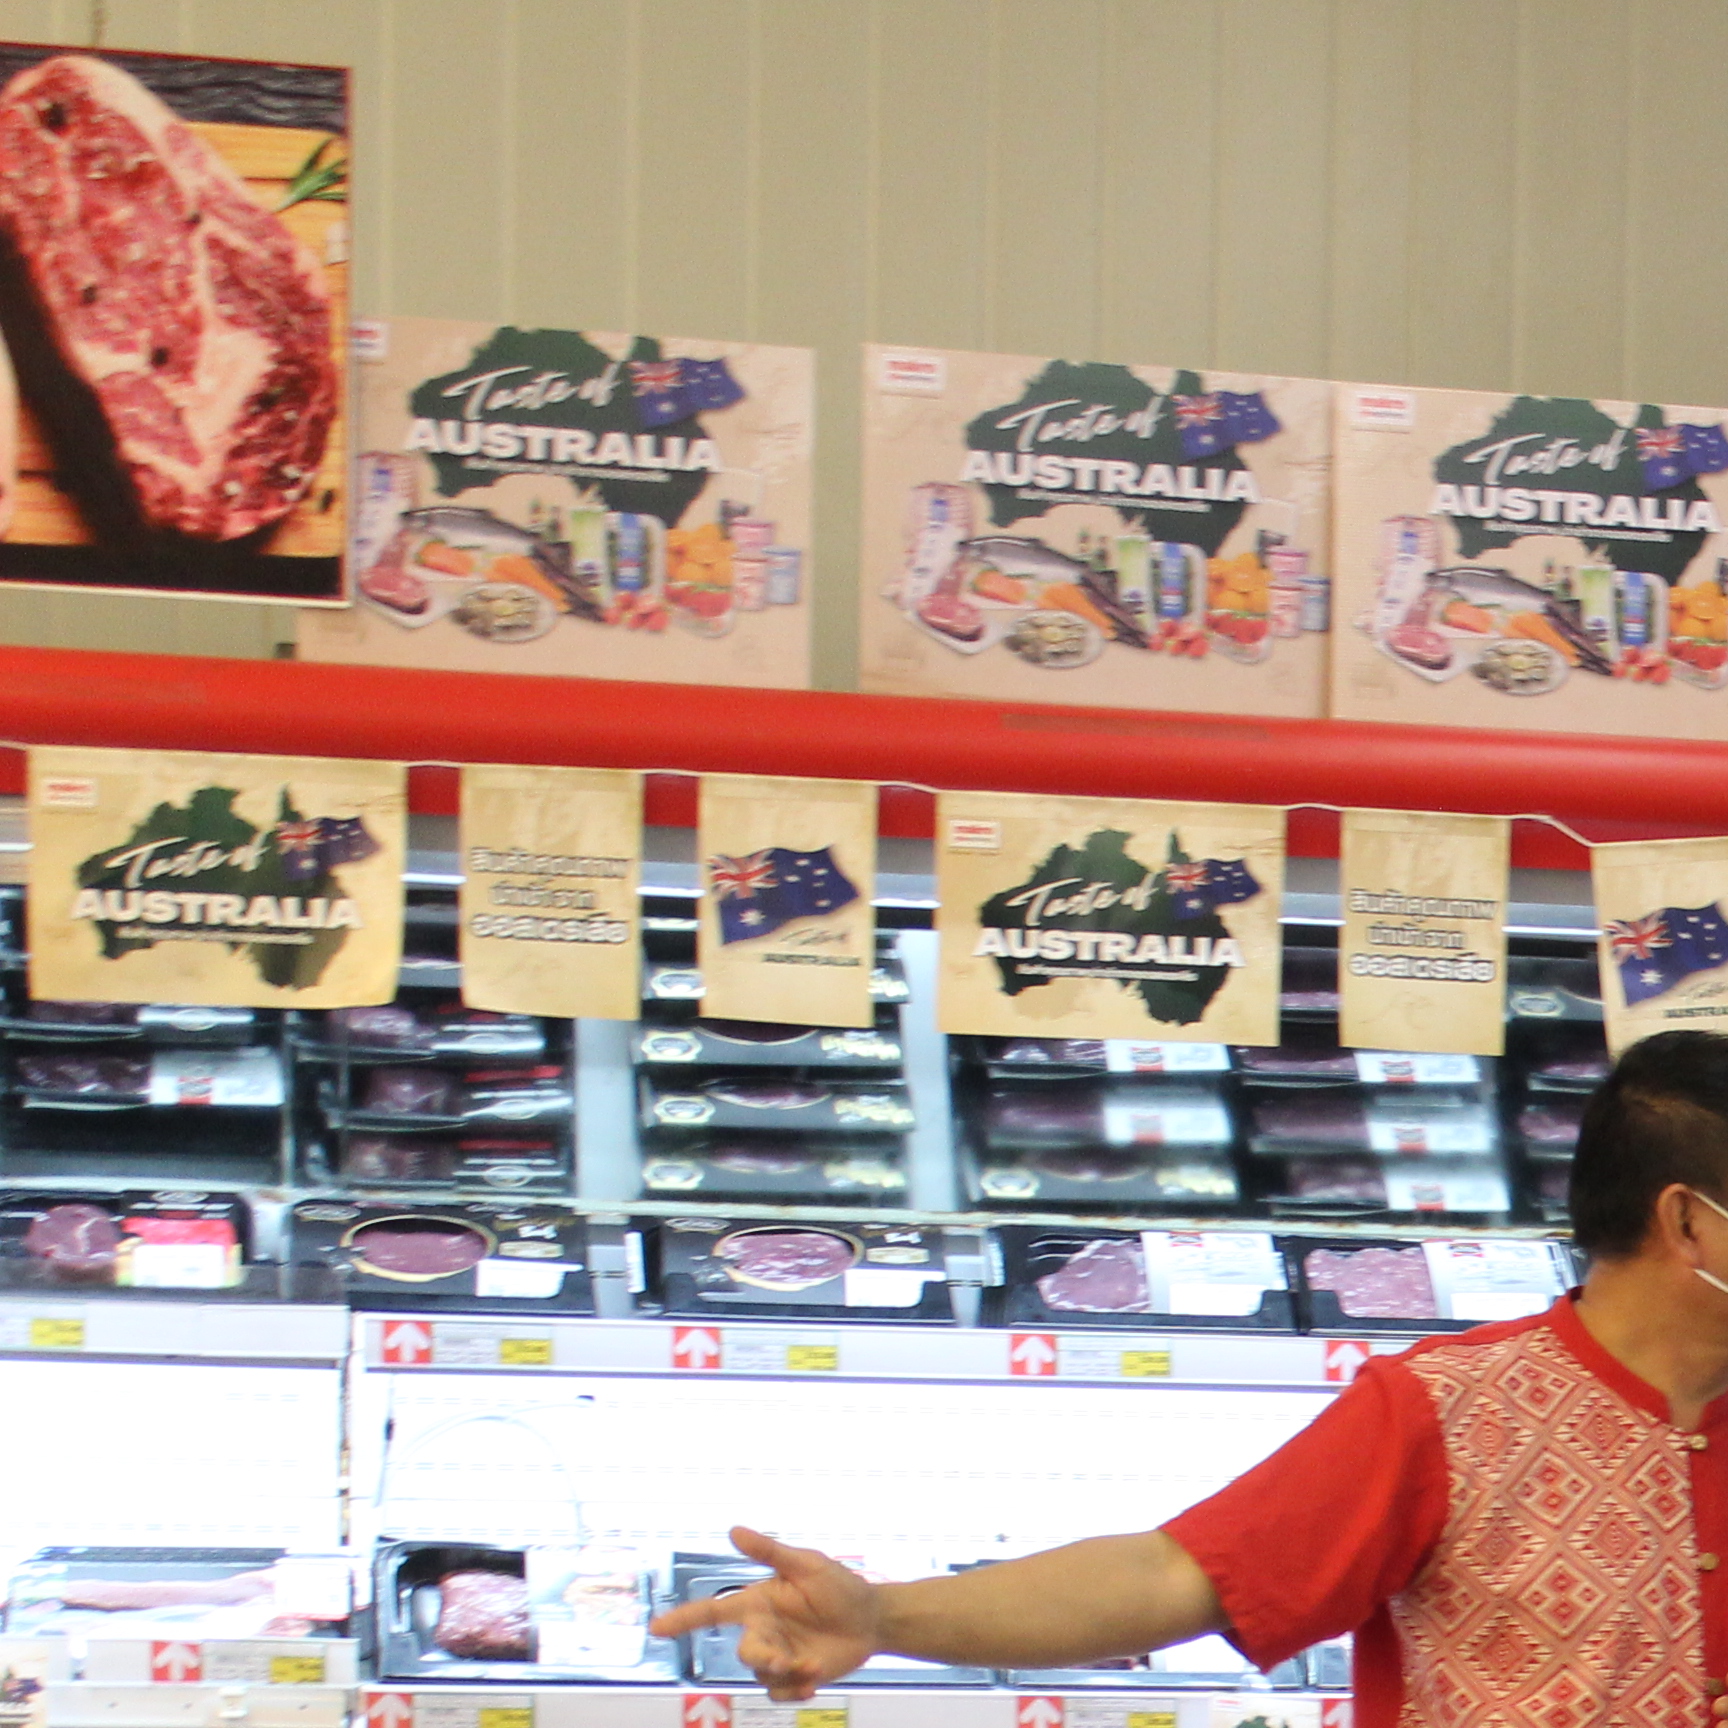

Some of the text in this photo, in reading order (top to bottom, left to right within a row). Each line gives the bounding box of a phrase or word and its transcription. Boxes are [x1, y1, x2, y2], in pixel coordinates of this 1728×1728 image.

[407, 418, 724, 472] AUSTRALIA
[961, 450, 1261, 503] AUSTRALIA
[1429, 484, 1720, 532] AUSTRALIA
[72, 889, 362, 929] AUSTRALIA
[971, 927, 1247, 968] AUSTRALIA
